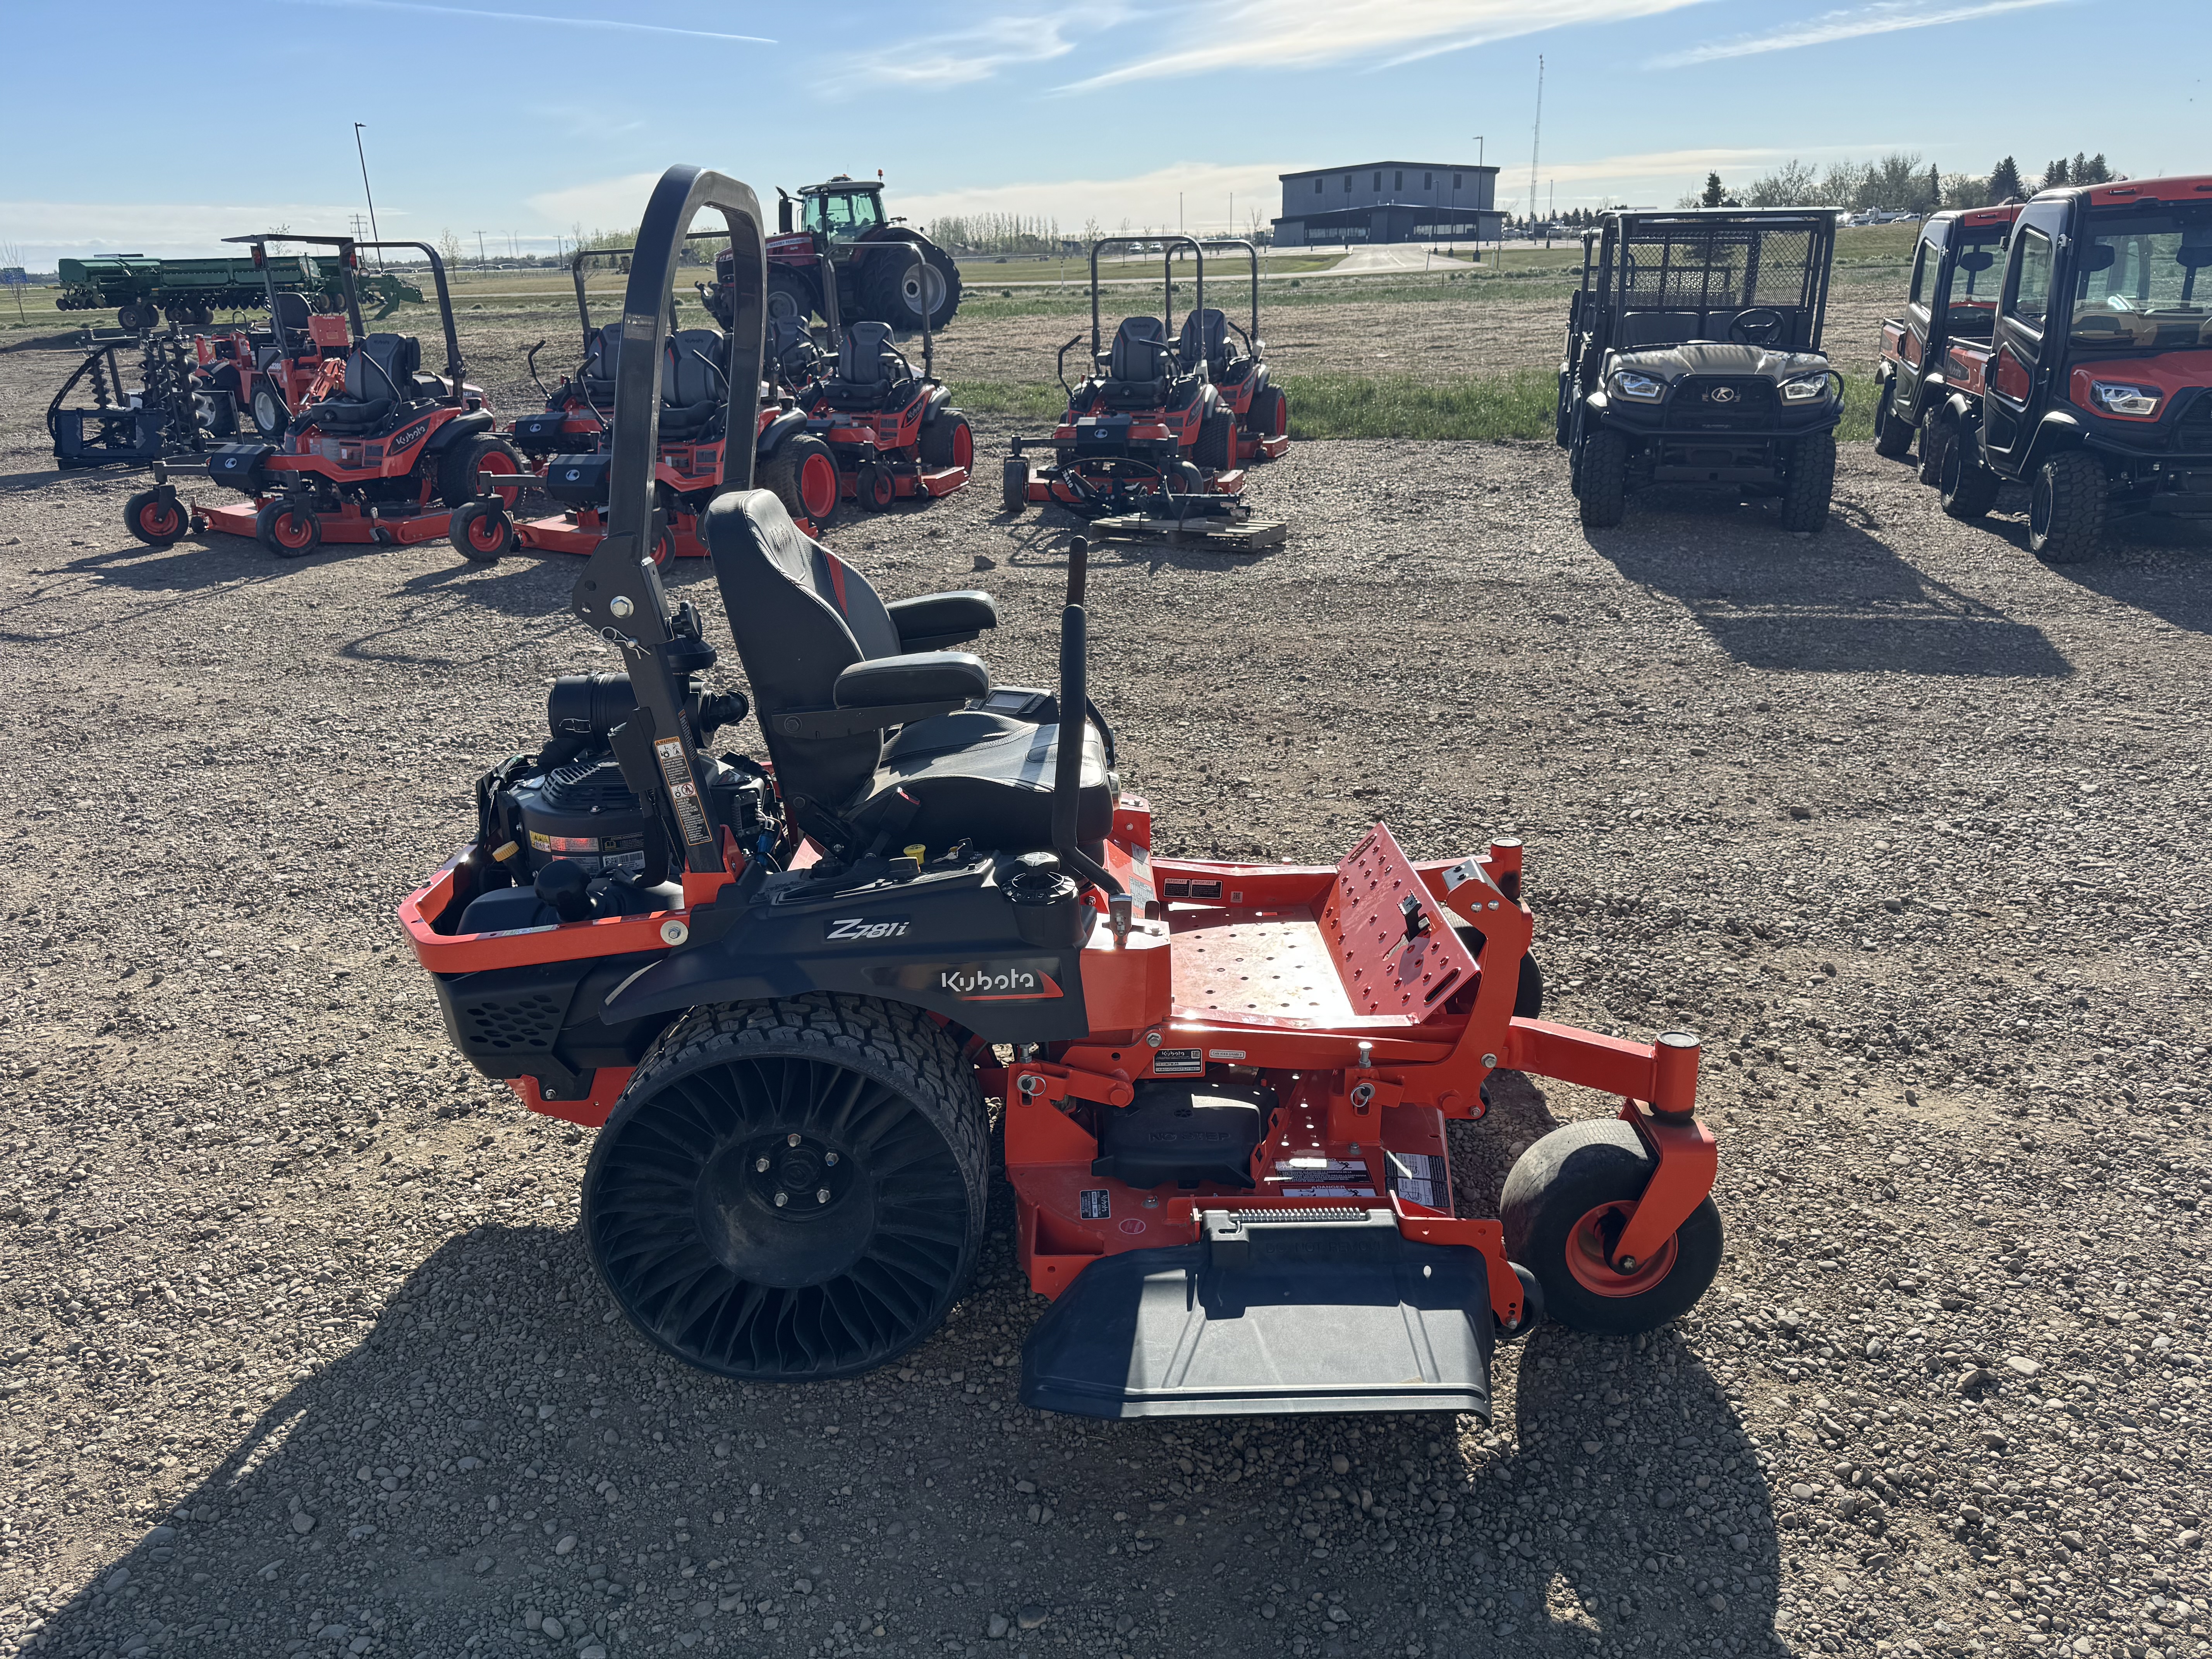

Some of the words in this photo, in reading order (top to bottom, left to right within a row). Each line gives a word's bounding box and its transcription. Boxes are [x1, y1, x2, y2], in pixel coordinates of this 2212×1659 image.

[395, 425, 426, 445] Kubota
[942, 968, 1034, 992] Kubota
[1149, 1132, 1177, 1142] NO
[1182, 1132, 1230, 1140] STEP
[1295, 1242, 1322, 1253] NOT
